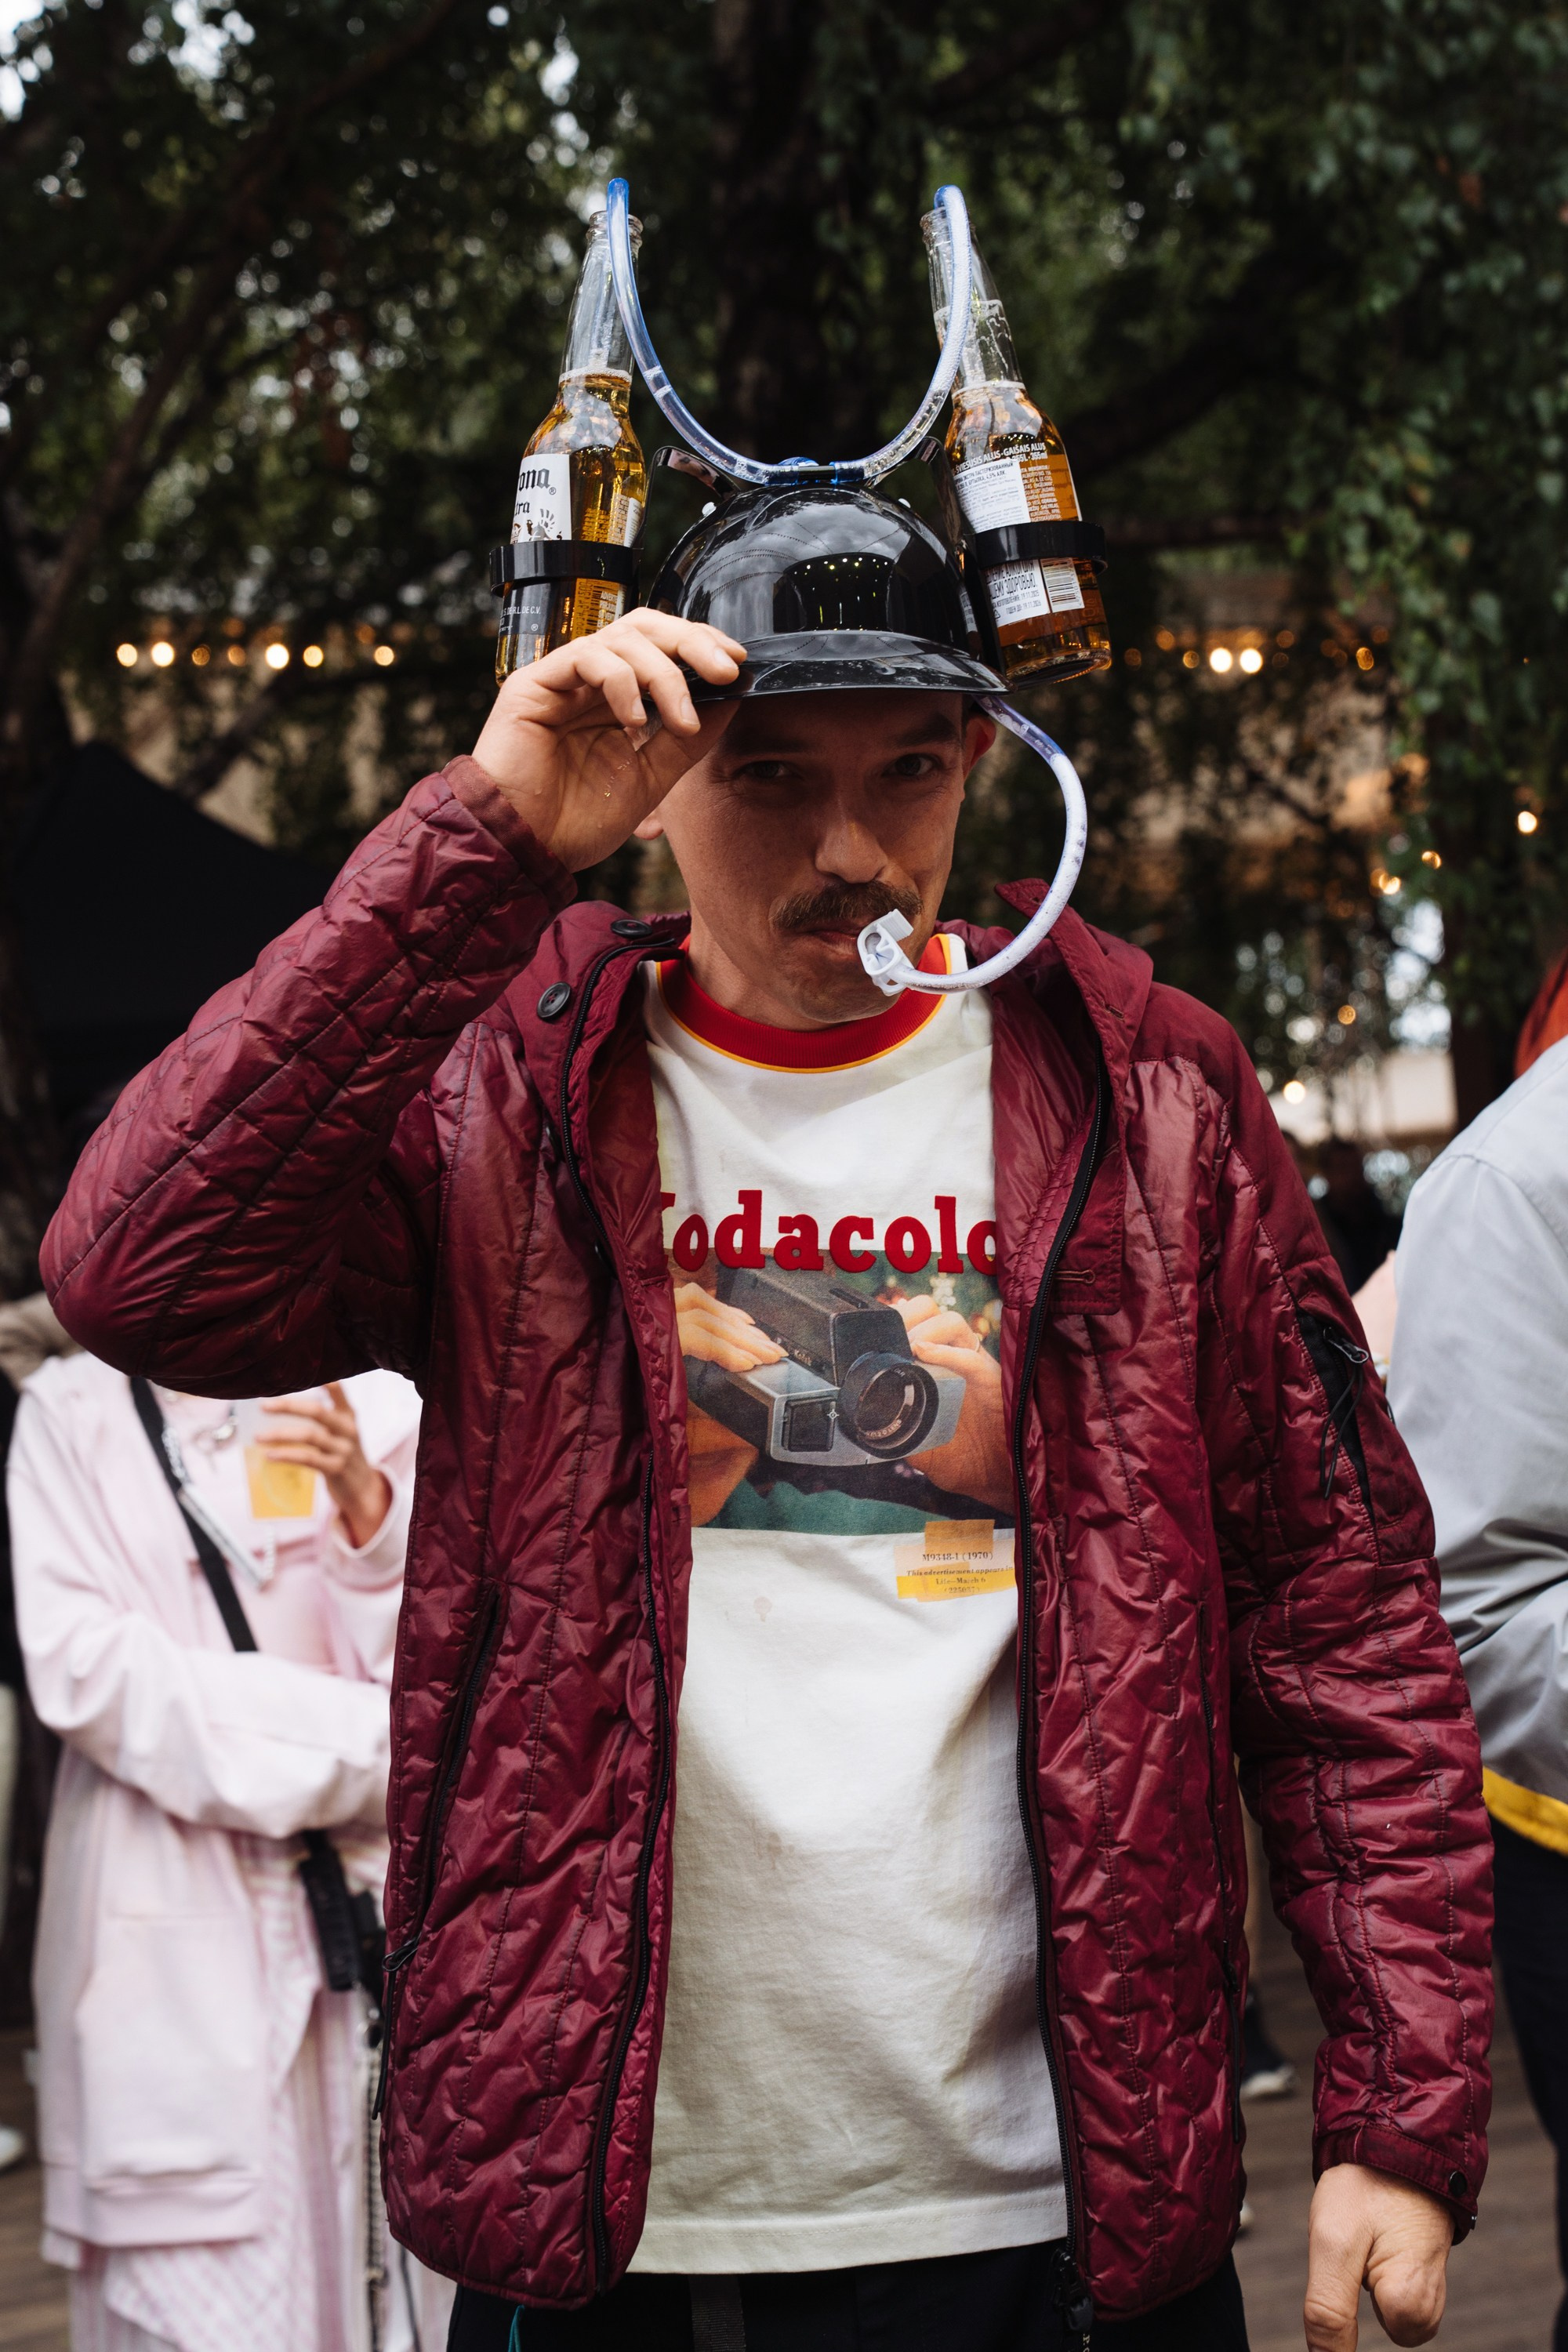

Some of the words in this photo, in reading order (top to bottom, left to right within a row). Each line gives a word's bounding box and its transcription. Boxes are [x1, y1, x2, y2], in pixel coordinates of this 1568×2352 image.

[983, 449, 1001, 463] ALUS
[1003, 445, 1030, 456] GAIŠAIS
[1030, 442, 1046, 452] ALUS
[922, 1552, 959, 1562] M9348-1
[963, 1552, 993, 1562] (1970)
